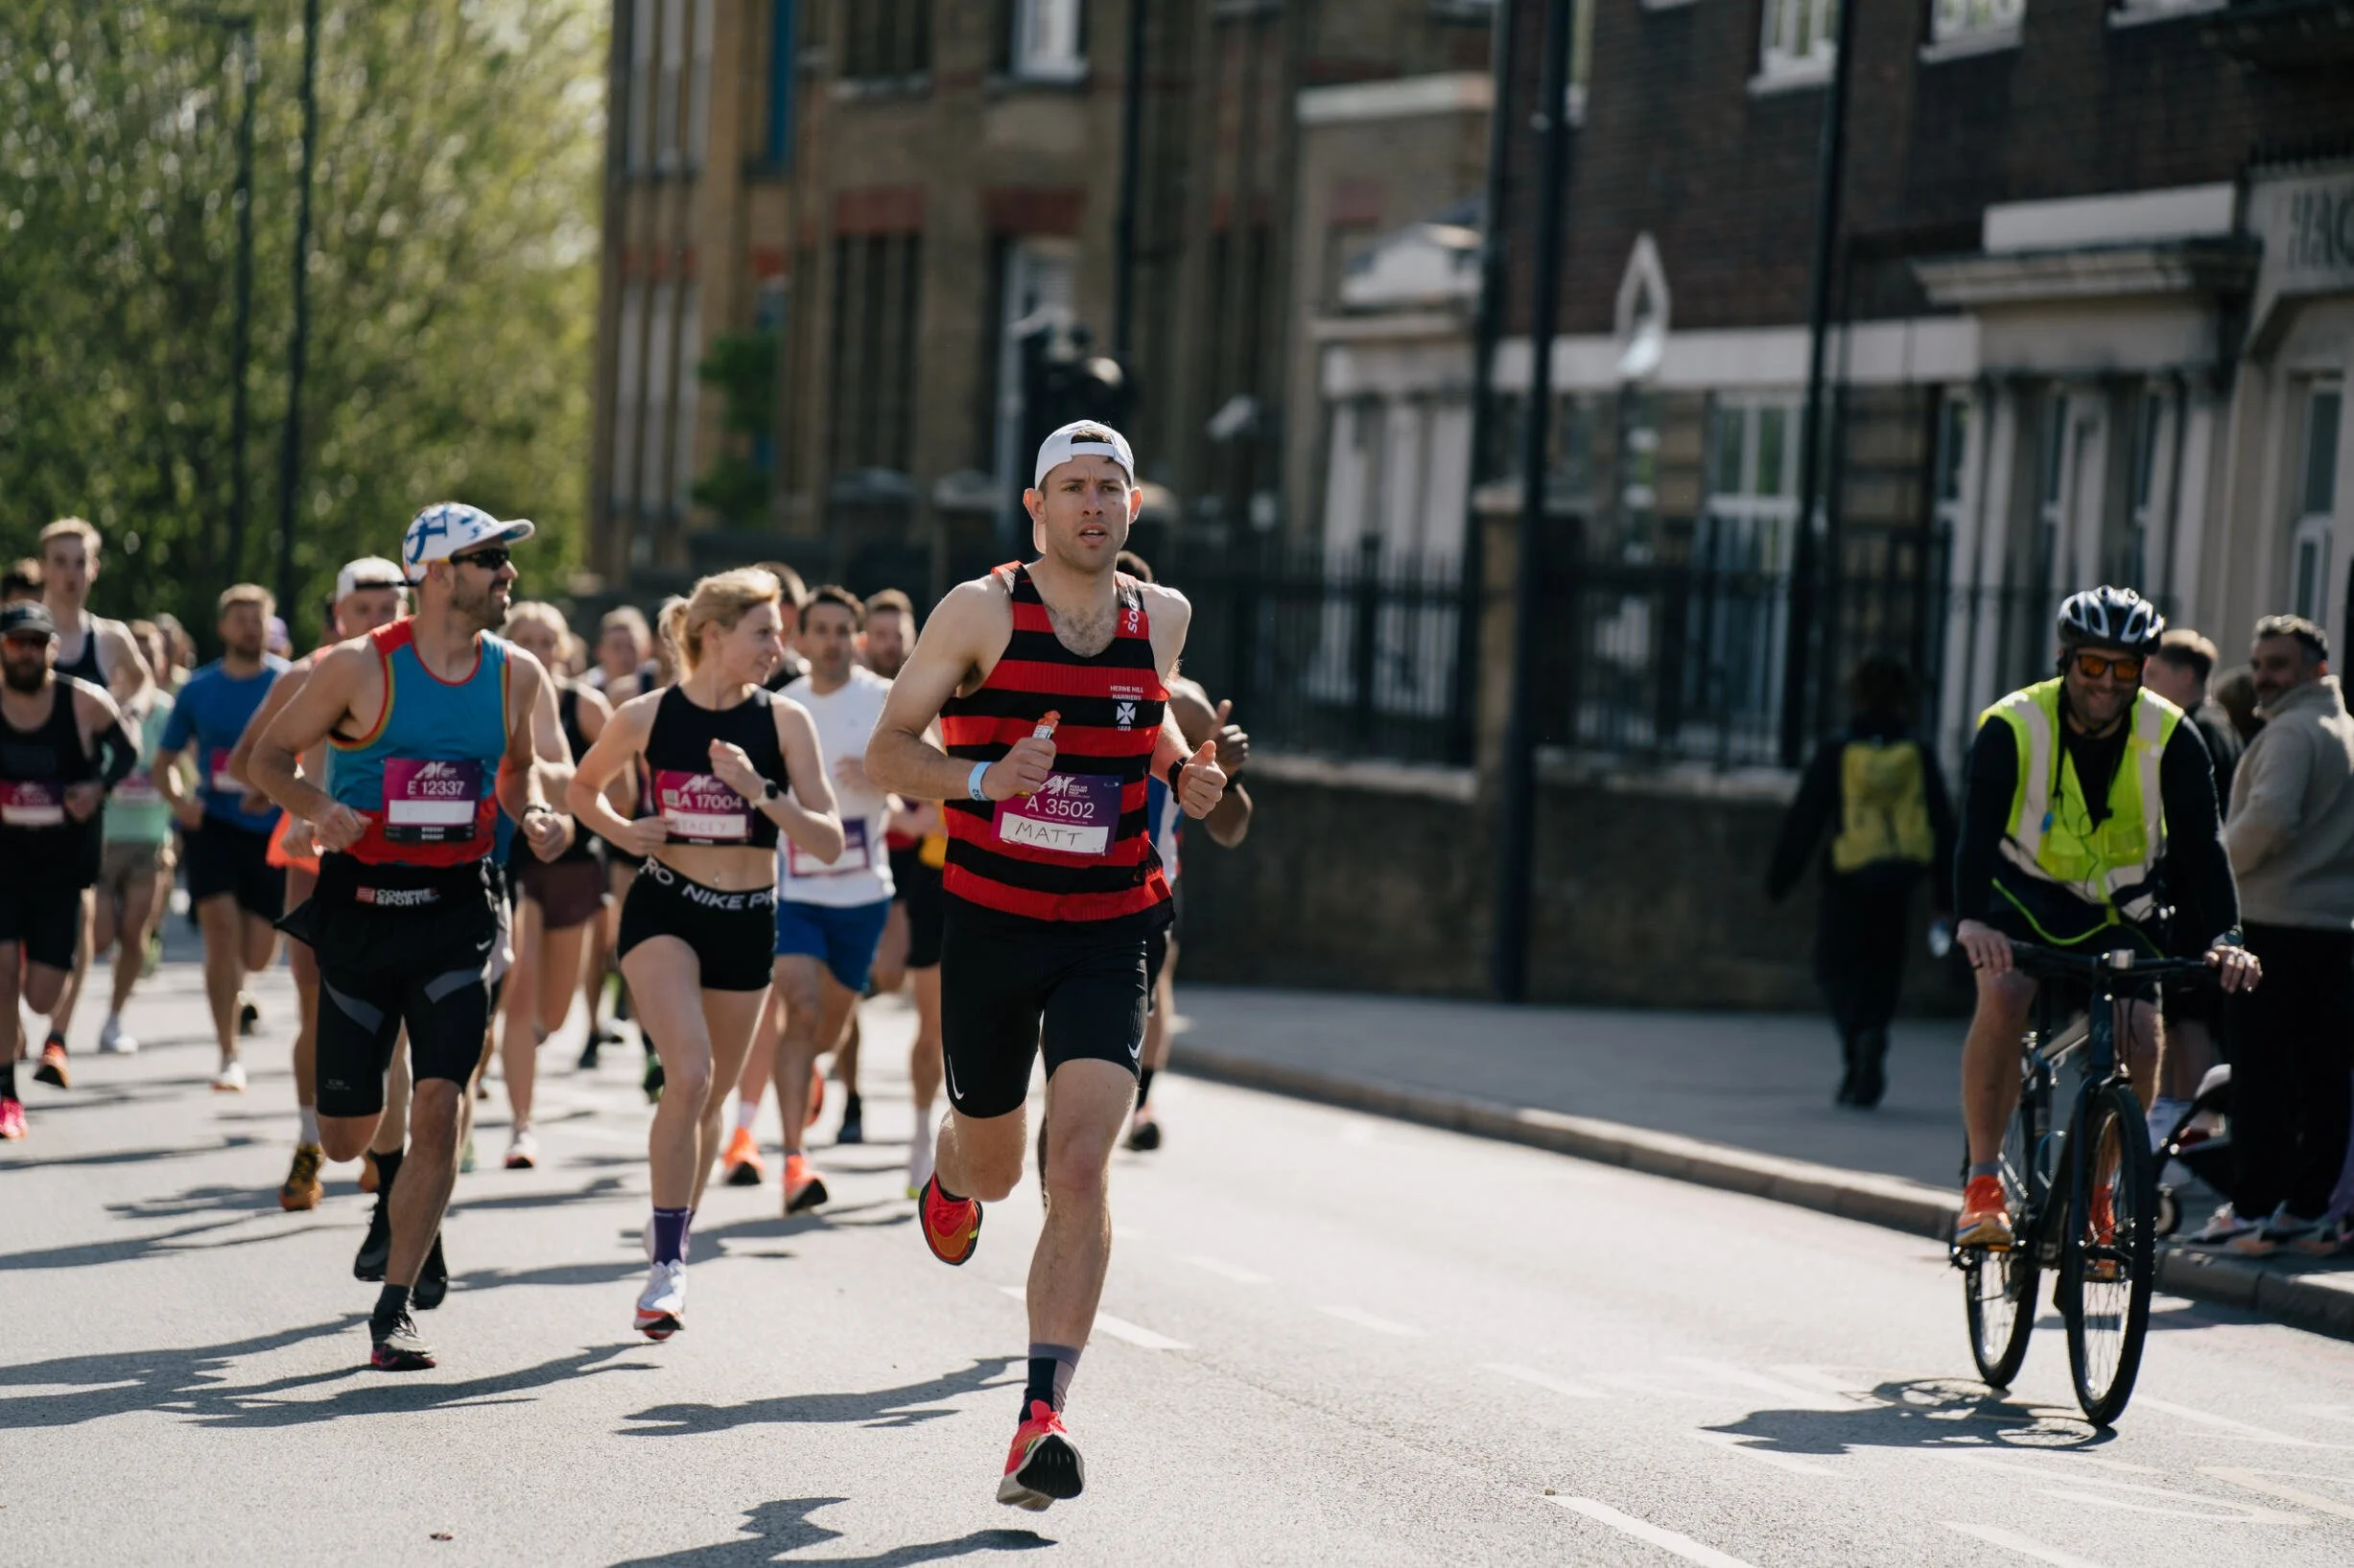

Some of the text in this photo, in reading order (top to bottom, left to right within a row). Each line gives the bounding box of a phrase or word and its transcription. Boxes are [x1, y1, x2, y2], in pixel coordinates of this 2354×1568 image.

[407, 780, 465, 796] E 12337
[680, 793, 742, 809] A 17004
[1024, 795, 1039, 812] A
[1045, 798, 1095, 819] 3502
[1015, 822, 1083, 846] MATT
[681, 883, 745, 909] NIKE
